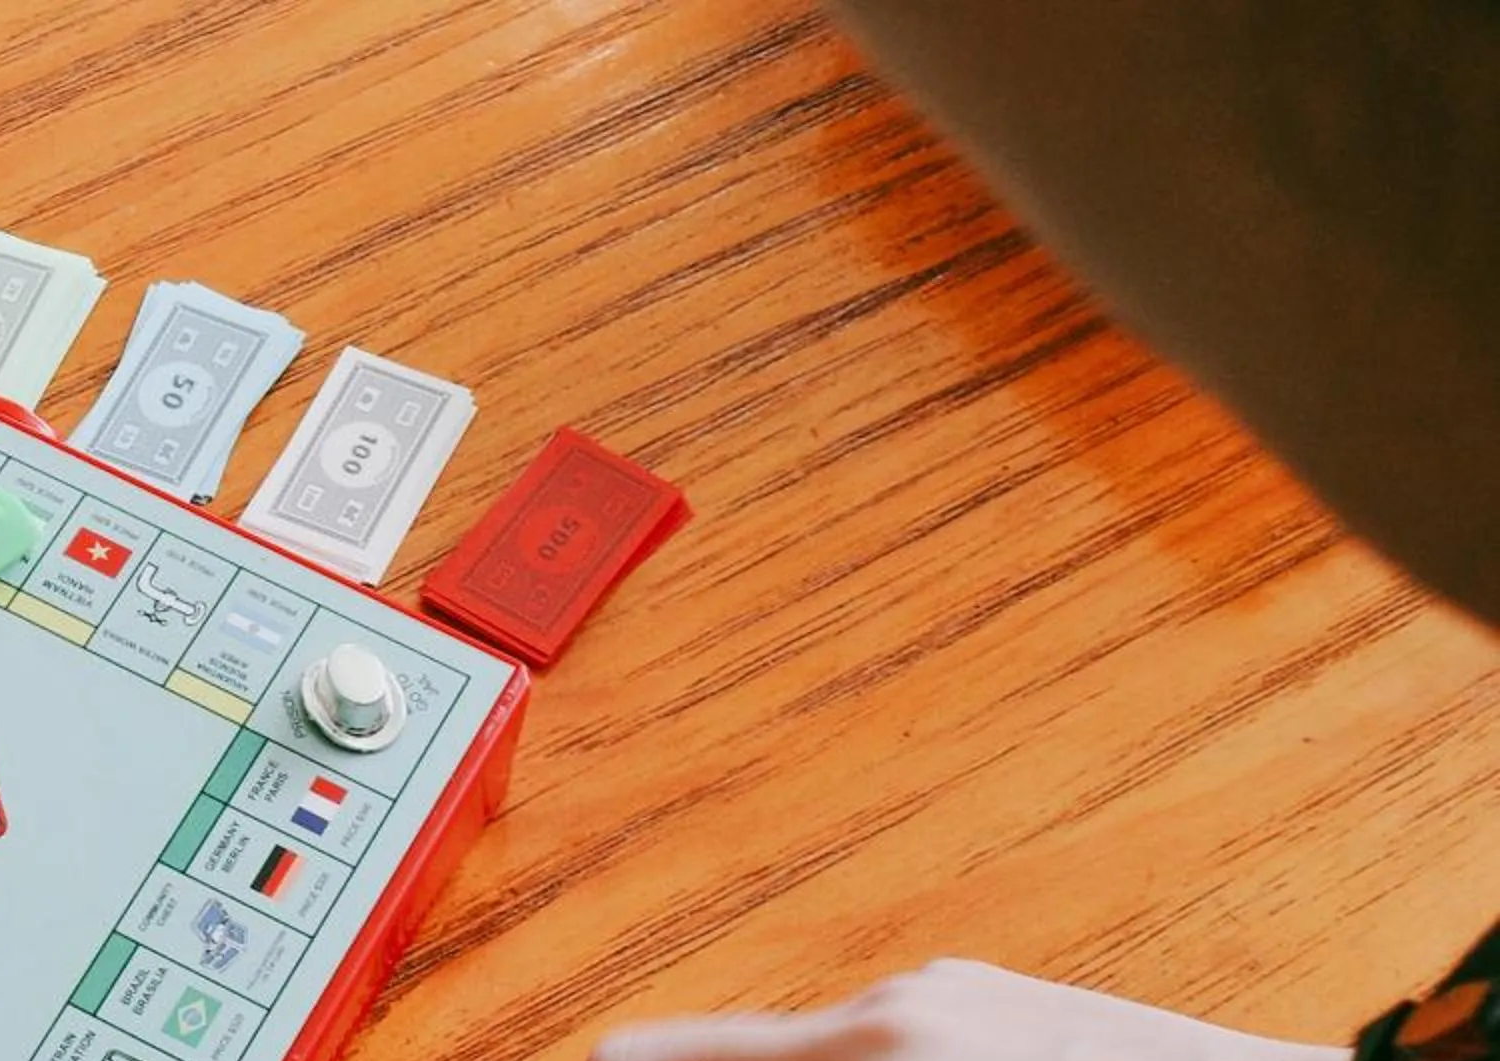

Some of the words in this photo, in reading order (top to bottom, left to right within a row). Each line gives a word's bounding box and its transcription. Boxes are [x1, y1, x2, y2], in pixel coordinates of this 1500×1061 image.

[160, 374, 194, 411] 50
[342, 434, 378, 476] 100
[537, 515, 580, 562] 500
[40, 576, 93, 610] VIETNAM
[55, 570, 95, 596] HANOI
[195, 661, 249, 693] ARGENTINA
[246, 757, 279, 802] FRANCE
[262, 769, 288, 803] PARIS
[203, 818, 242, 873] GERMANY
[219, 832, 251, 875] BERLIN
[136, 880, 174, 934] COMMUNITY
[119, 964, 151, 1007] BRAZIL
[131, 964, 168, 1016] BRASILIA
